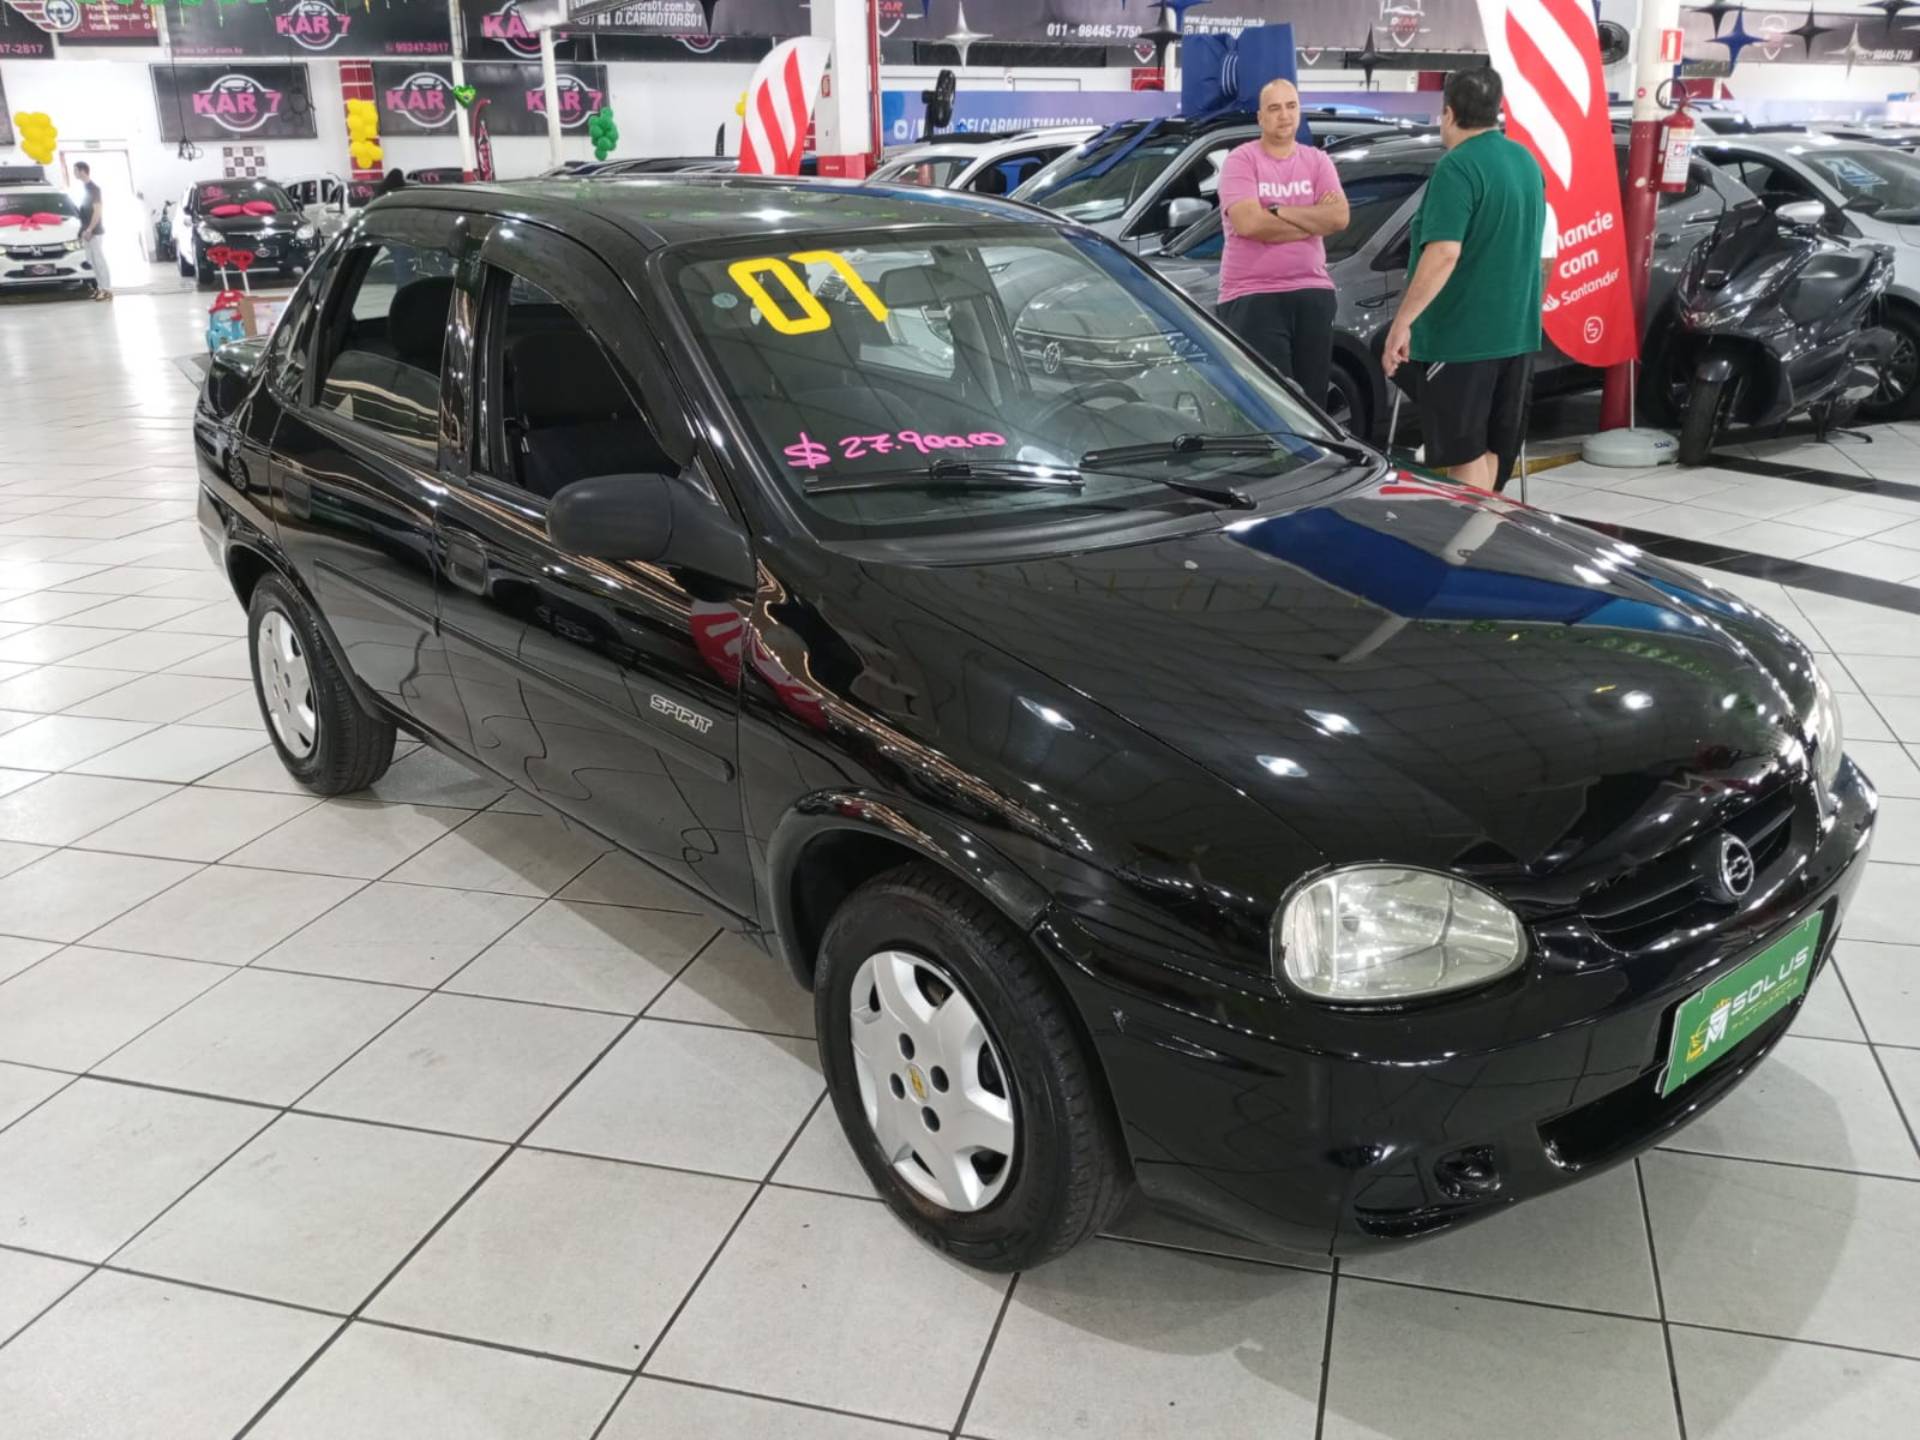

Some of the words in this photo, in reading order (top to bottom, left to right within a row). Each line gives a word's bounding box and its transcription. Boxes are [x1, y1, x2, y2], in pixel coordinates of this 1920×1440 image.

[276, 16, 331, 34] KAR
[340, 16, 351, 34] 7
[483, 15, 536, 39] KA
[1047, 22, 1068, 37] 011
[1078, 23, 1143, 38] 98445-7750
[192, 92, 257, 114] KAR
[265, 92, 283, 114] 7
[386, 90, 445, 111] KAR
[526, 90, 581, 111] KR
[588, 90, 603, 111] 7
[1557, 210, 1614, 250] nancie
[1559, 249, 1599, 279] com
[727, 249, 891, 336] 07
[1560, 267, 1620, 306] Santander
[650, 693, 713, 734] SPIRIT
[1730, 946, 1809, 1017] SOLUS
